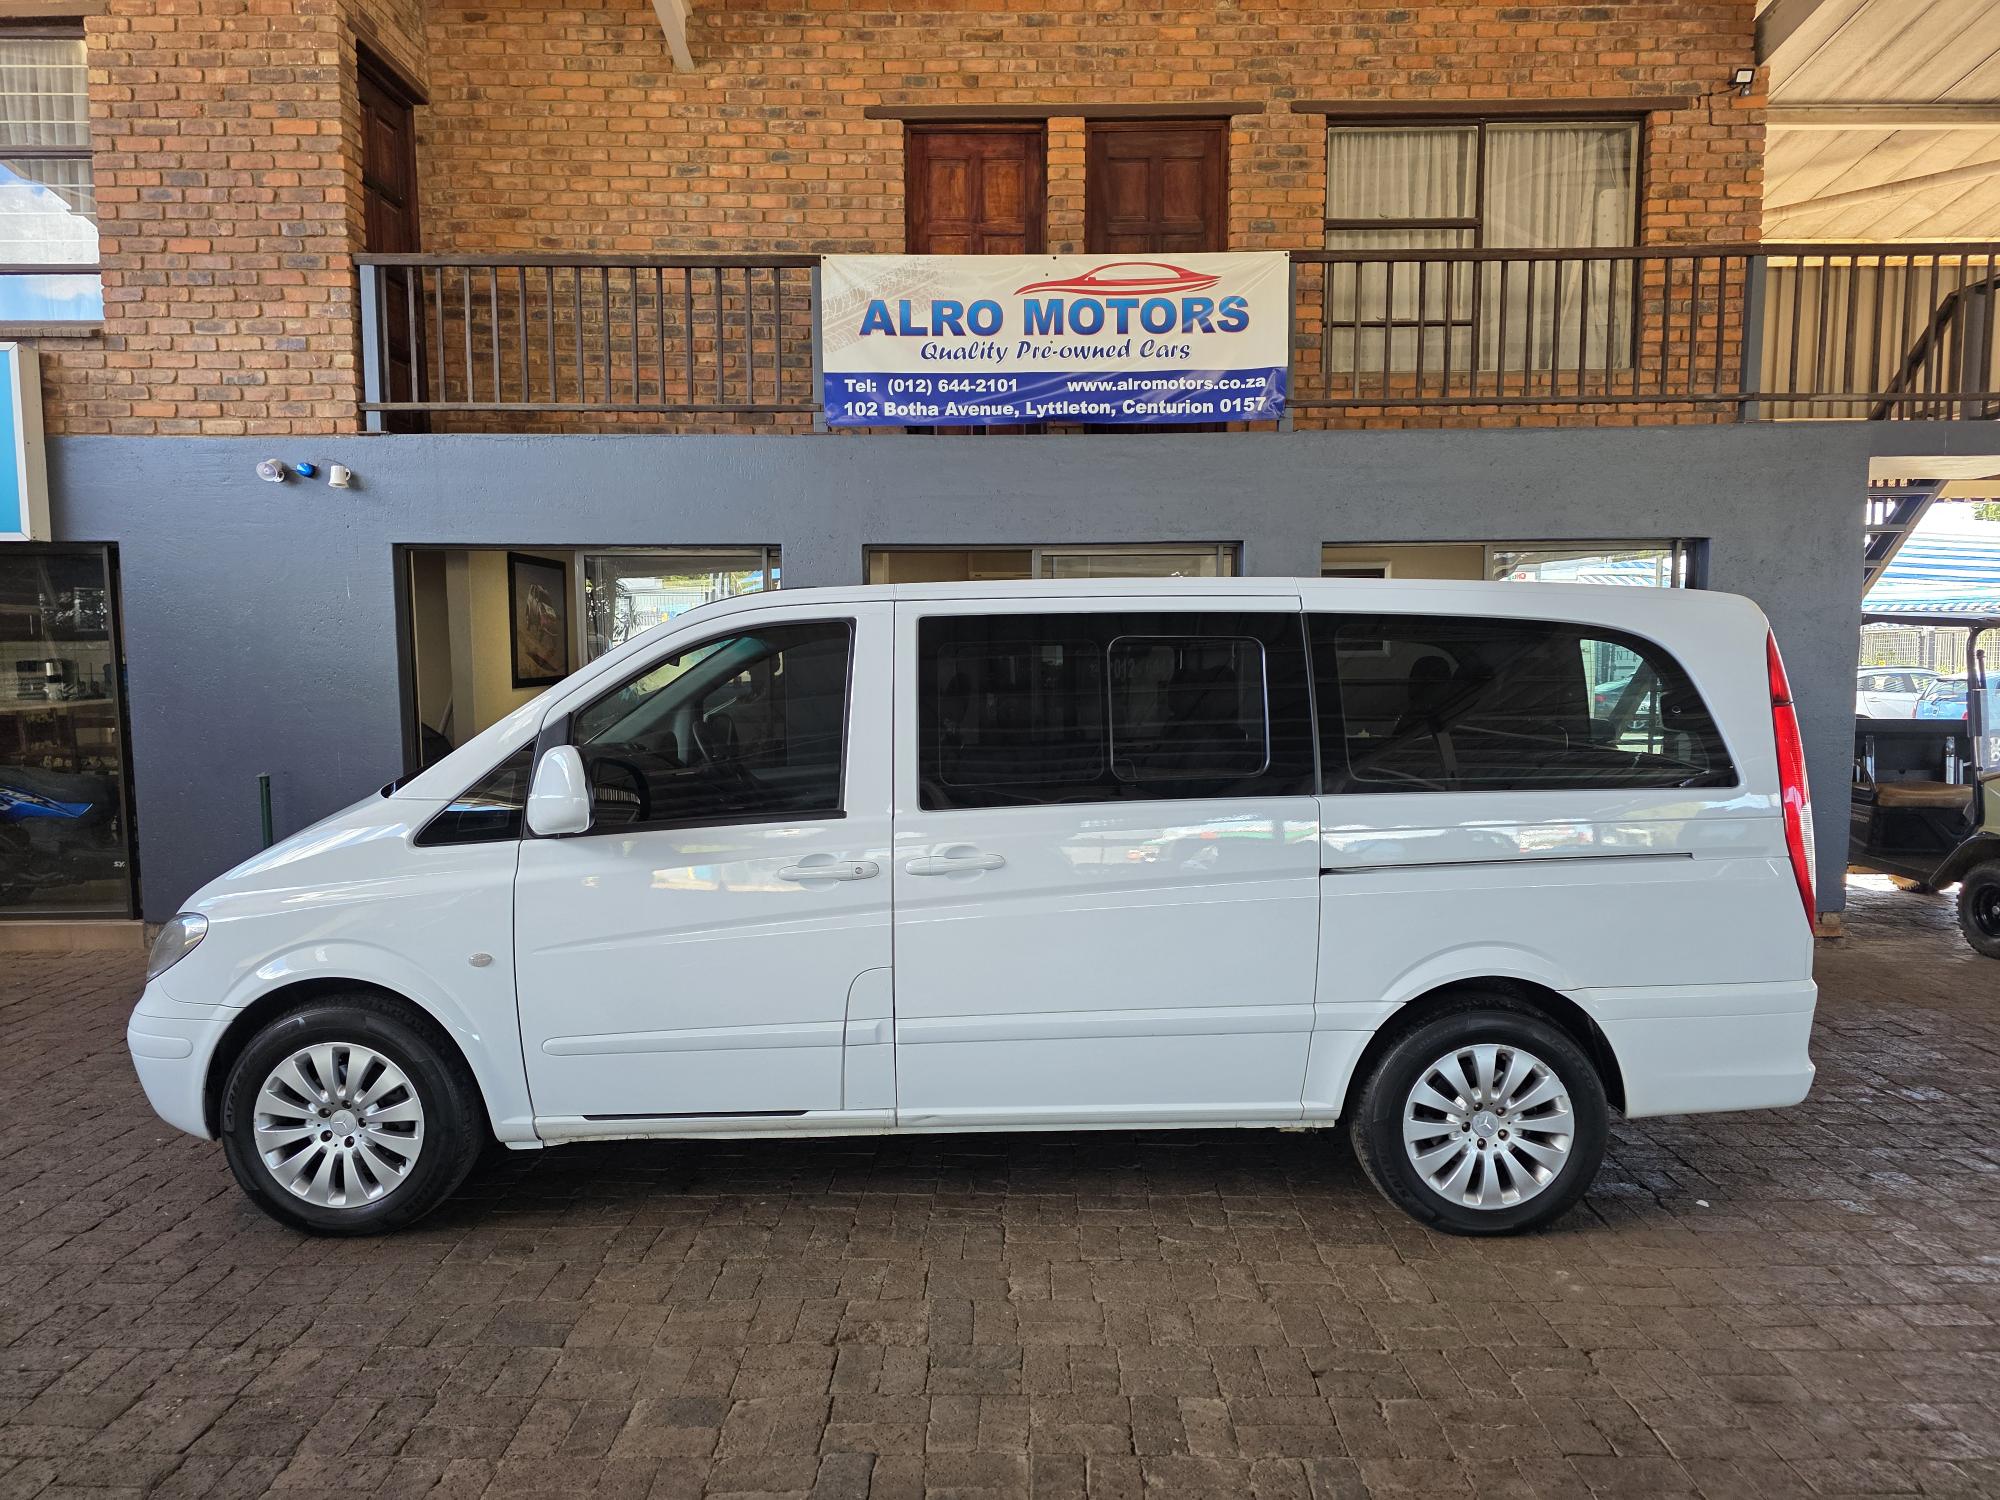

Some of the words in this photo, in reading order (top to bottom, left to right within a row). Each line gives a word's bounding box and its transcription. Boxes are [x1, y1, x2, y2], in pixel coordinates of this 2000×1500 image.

[858, 297, 1004, 337] ALRO
[1023, 295, 1250, 337] MOTORS
[920, 340, 1008, 364] Quality
[1016, 338, 1131, 360] Pre-owned
[1139, 338, 1190, 360] Cars
[844, 379, 877, 392] Tel:
[887, 379, 932, 396] (012)
[938, 378, 1018, 393] 644-2101
[1066, 376, 1266, 392] www.alromotors.co.za
[844, 402, 878, 417] 102
[884, 402, 939, 417] Botha
[944, 401, 1020, 418] Avenue,
[1025, 400, 1117, 418] Lyttleton,
[1122, 399, 1214, 415] Centurion
[1219, 396, 1267, 413] 0157
